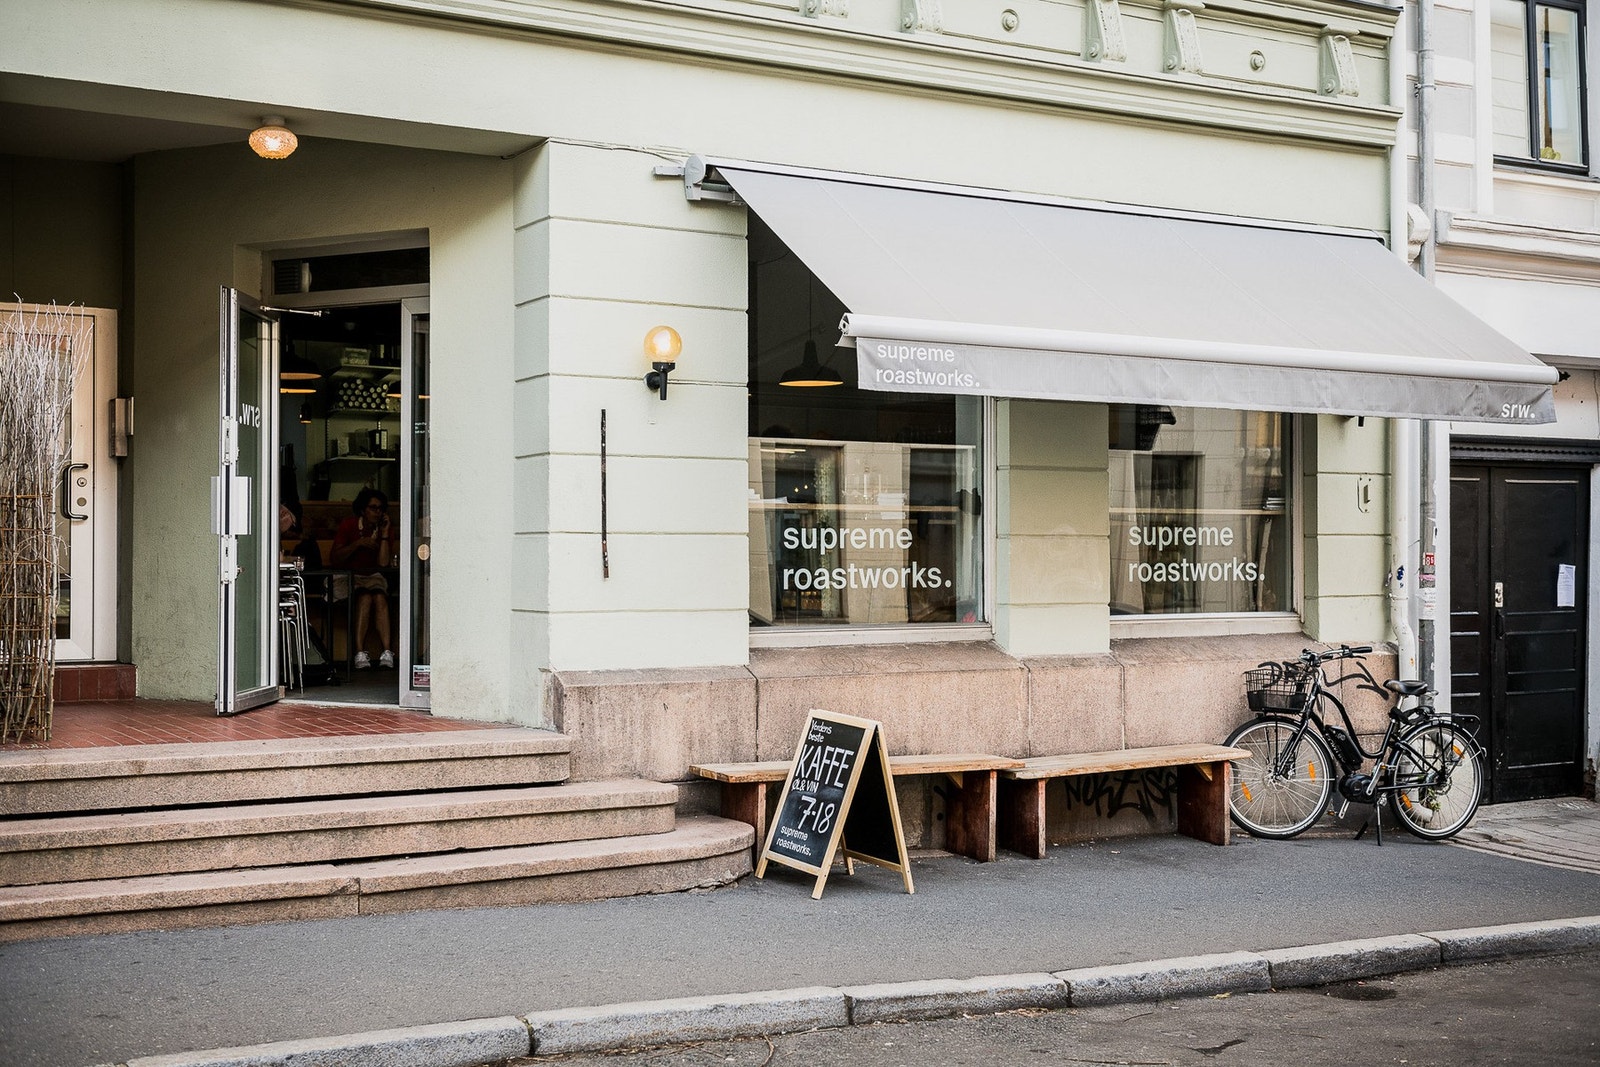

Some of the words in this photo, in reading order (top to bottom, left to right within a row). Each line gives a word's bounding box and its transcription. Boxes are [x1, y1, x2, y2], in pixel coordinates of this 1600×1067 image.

[877, 344, 955, 363] supreme
[876, 368, 980, 388] roastworks.
[1501, 403, 1536, 419] srw.
[783, 526, 913, 555] supreme
[1128, 525, 1234, 551] supreme
[783, 561, 952, 590] roastworks.
[1128, 557, 1265, 582] roastworks.
[795, 744, 855, 788] KAFFE
[780, 825, 808, 841] supreme
[776, 837, 812, 857] roastworks.
